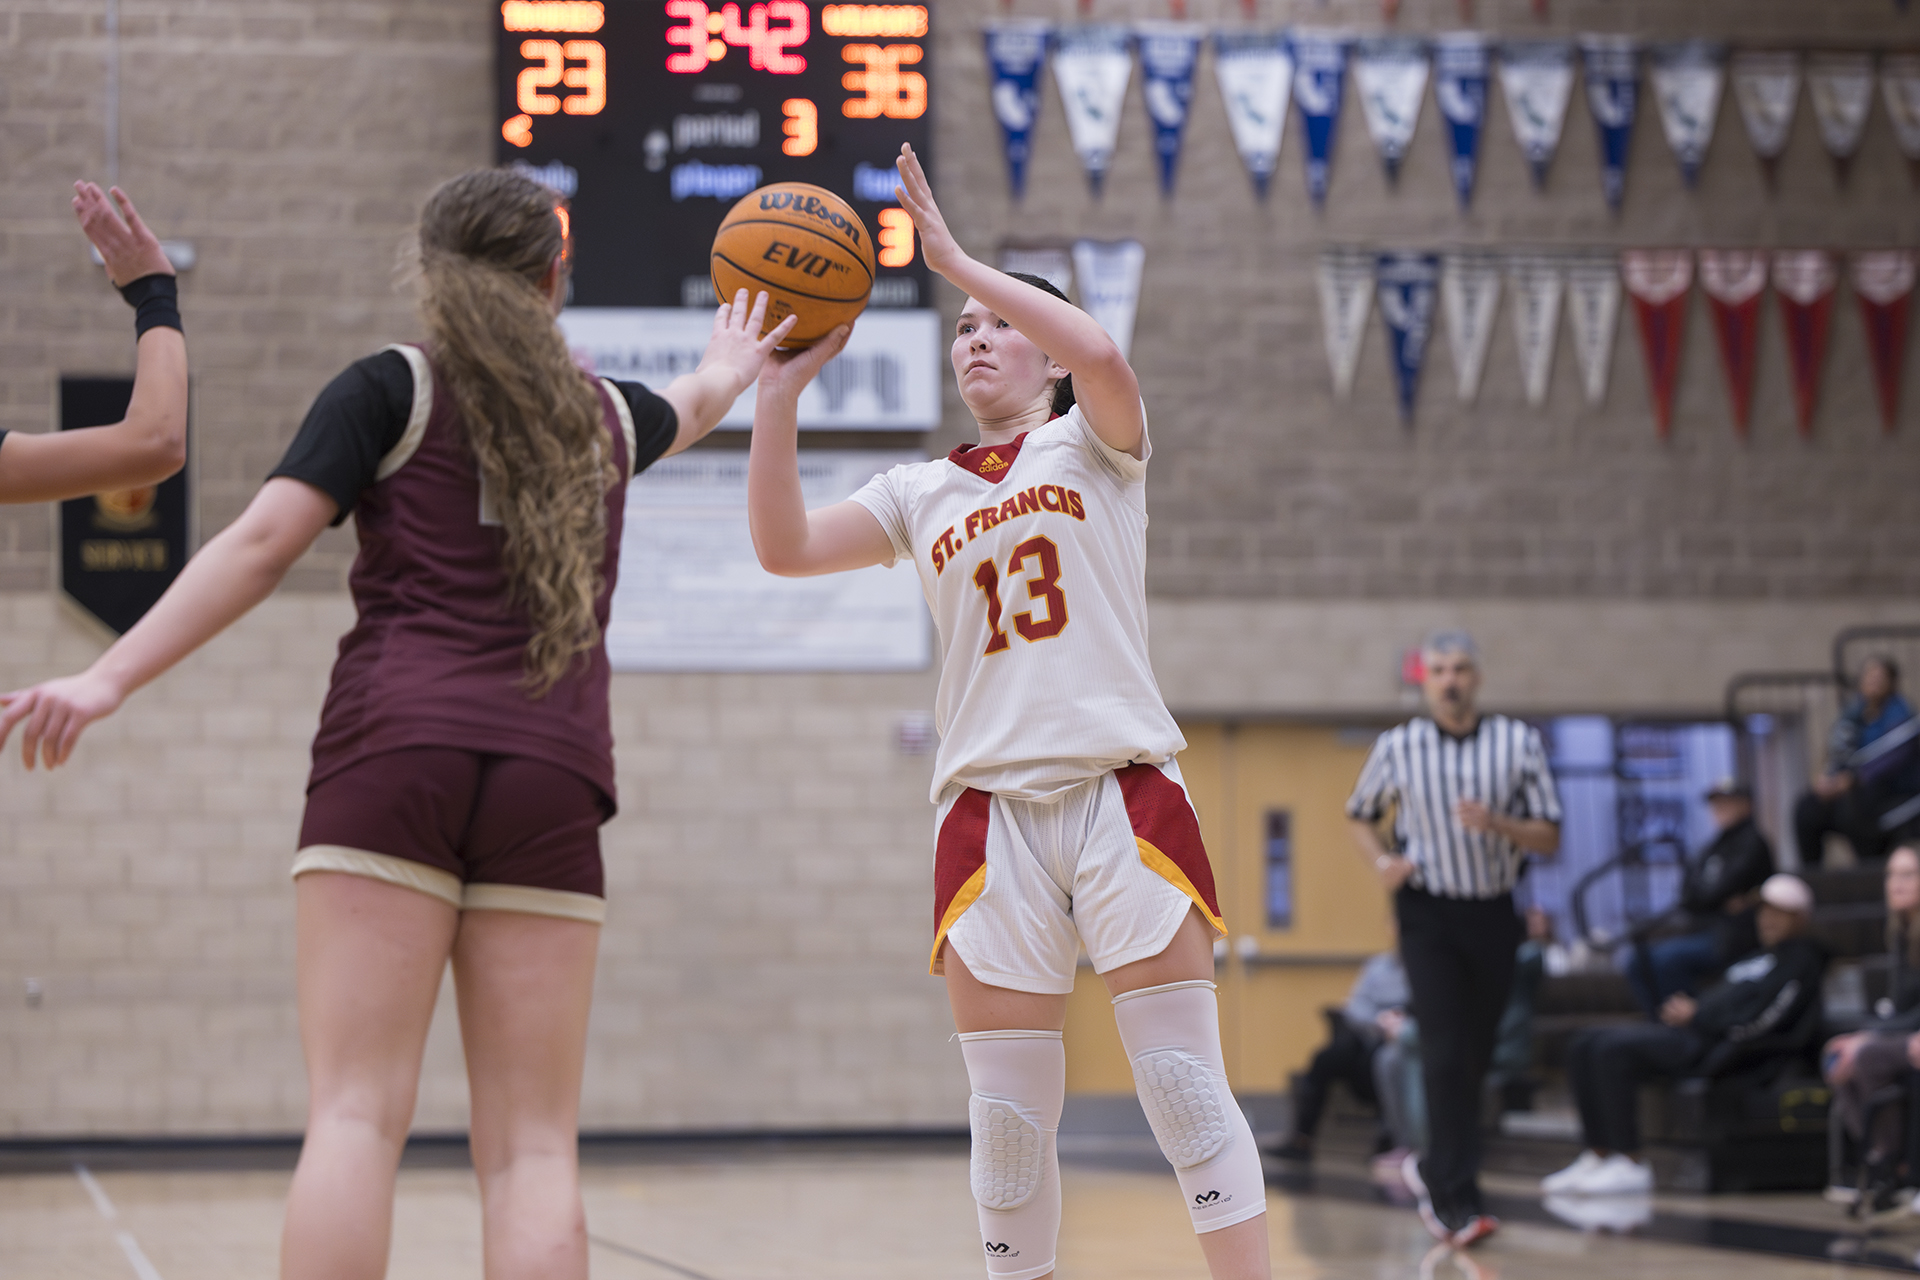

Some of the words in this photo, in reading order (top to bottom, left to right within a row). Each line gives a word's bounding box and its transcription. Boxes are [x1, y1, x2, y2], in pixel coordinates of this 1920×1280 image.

[665, 0, 811, 74] 3:42
[517, 39, 606, 115] 23
[841, 43, 928, 119] 36
[782, 98, 818, 156] 3
[759, 192, 862, 251] Wilson
[878, 208, 914, 267] 3
[762, 240, 833, 279] EVO
[979, 461, 1009, 473] adidas
[931, 525, 963, 578] ST.
[964, 484, 1086, 543] FRANCIS
[972, 534, 1070, 657] 13
